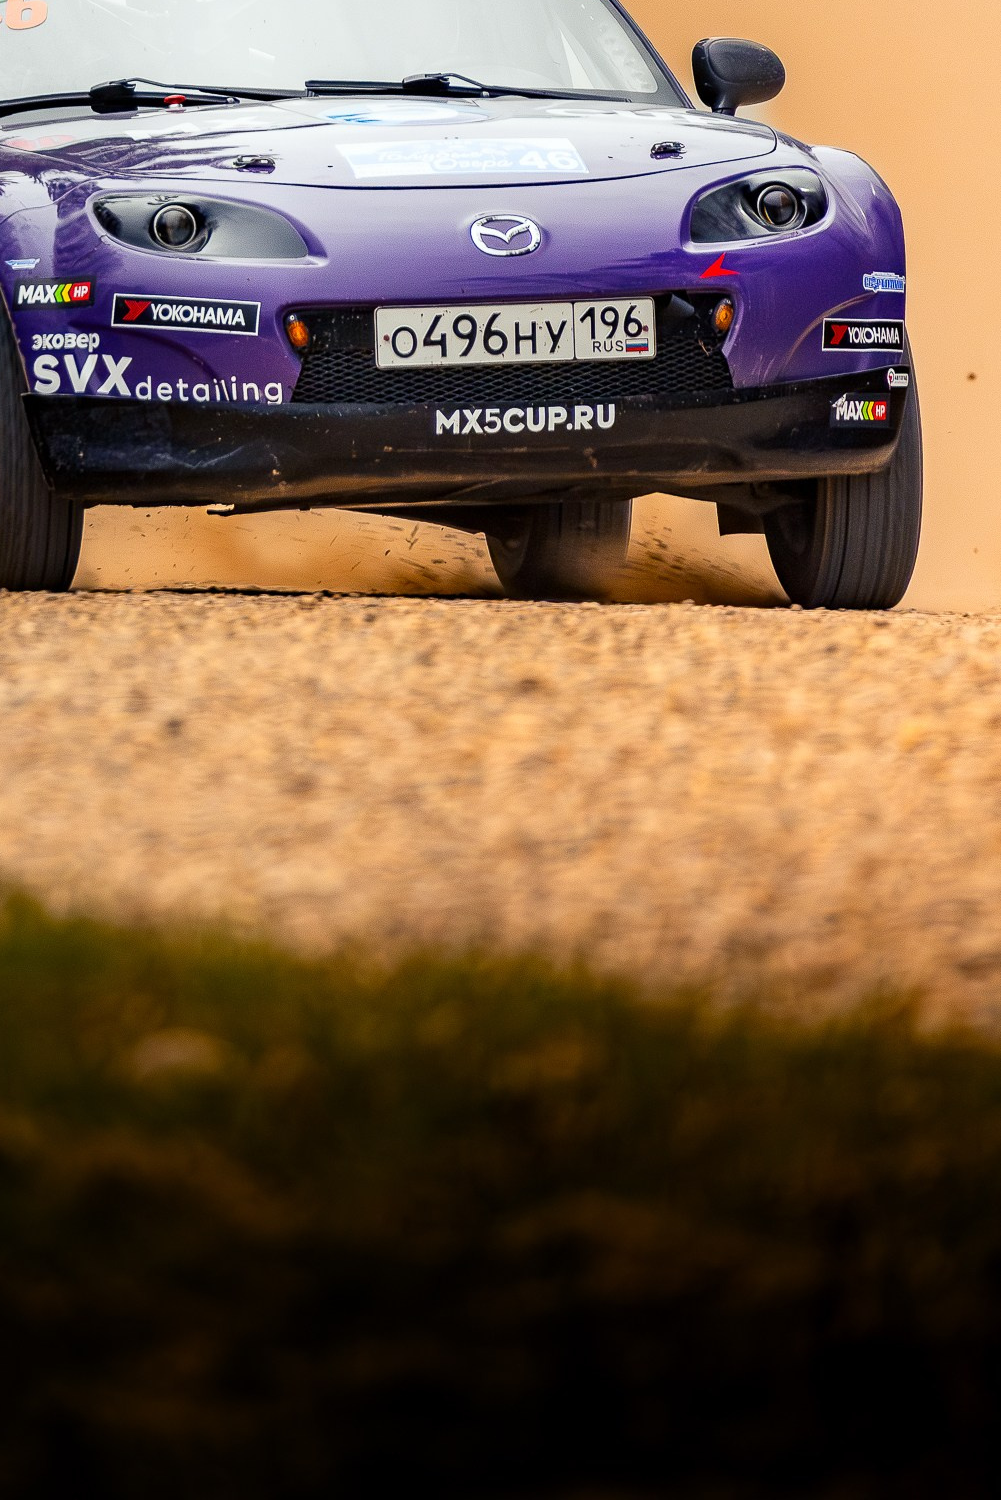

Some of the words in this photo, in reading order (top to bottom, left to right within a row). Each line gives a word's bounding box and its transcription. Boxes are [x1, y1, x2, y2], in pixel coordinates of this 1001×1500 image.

[519, 150, 580, 171] 46
[17, 284, 58, 305] MAX
[73, 285, 89, 298] HP
[150, 303, 246, 327] YOKOHAMA
[579, 304, 643, 340] 196
[31, 332, 100, 353] эковер
[847, 326, 901, 345] YOKOHAMA
[591, 340, 624, 353] RUS
[32, 353, 133, 396] SVX
[135, 375, 284, 406] detailing
[435, 403, 616, 435] MX5CUP.RU
[835, 399, 864, 421] MAX
[875, 404, 887, 417] HP
